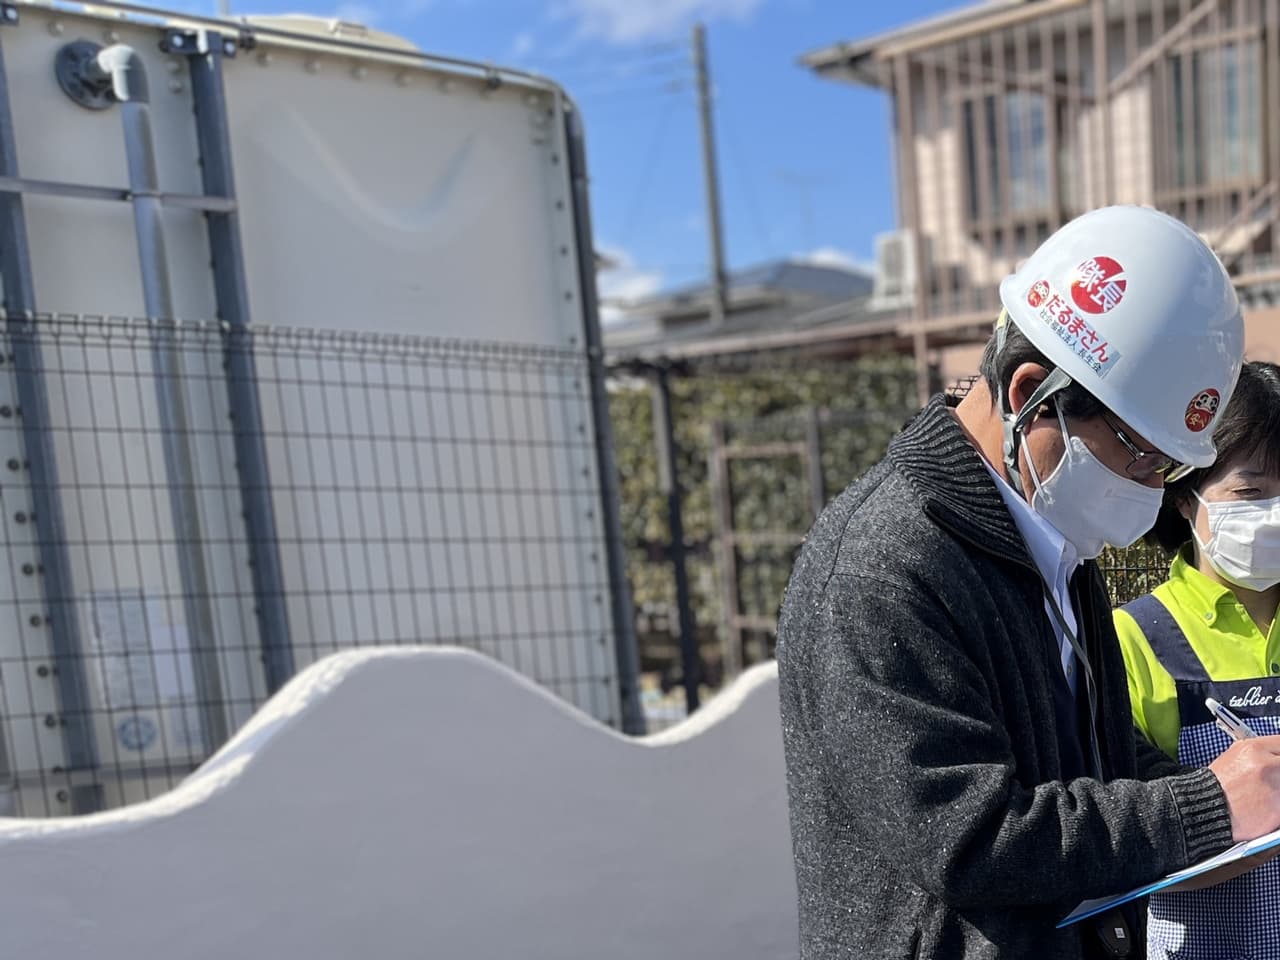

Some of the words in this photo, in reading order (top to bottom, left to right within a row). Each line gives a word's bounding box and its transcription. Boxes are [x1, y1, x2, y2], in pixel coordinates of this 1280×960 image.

[1075, 258, 1122, 312] 隊長
[1045, 293, 1109, 363] だるまさん
